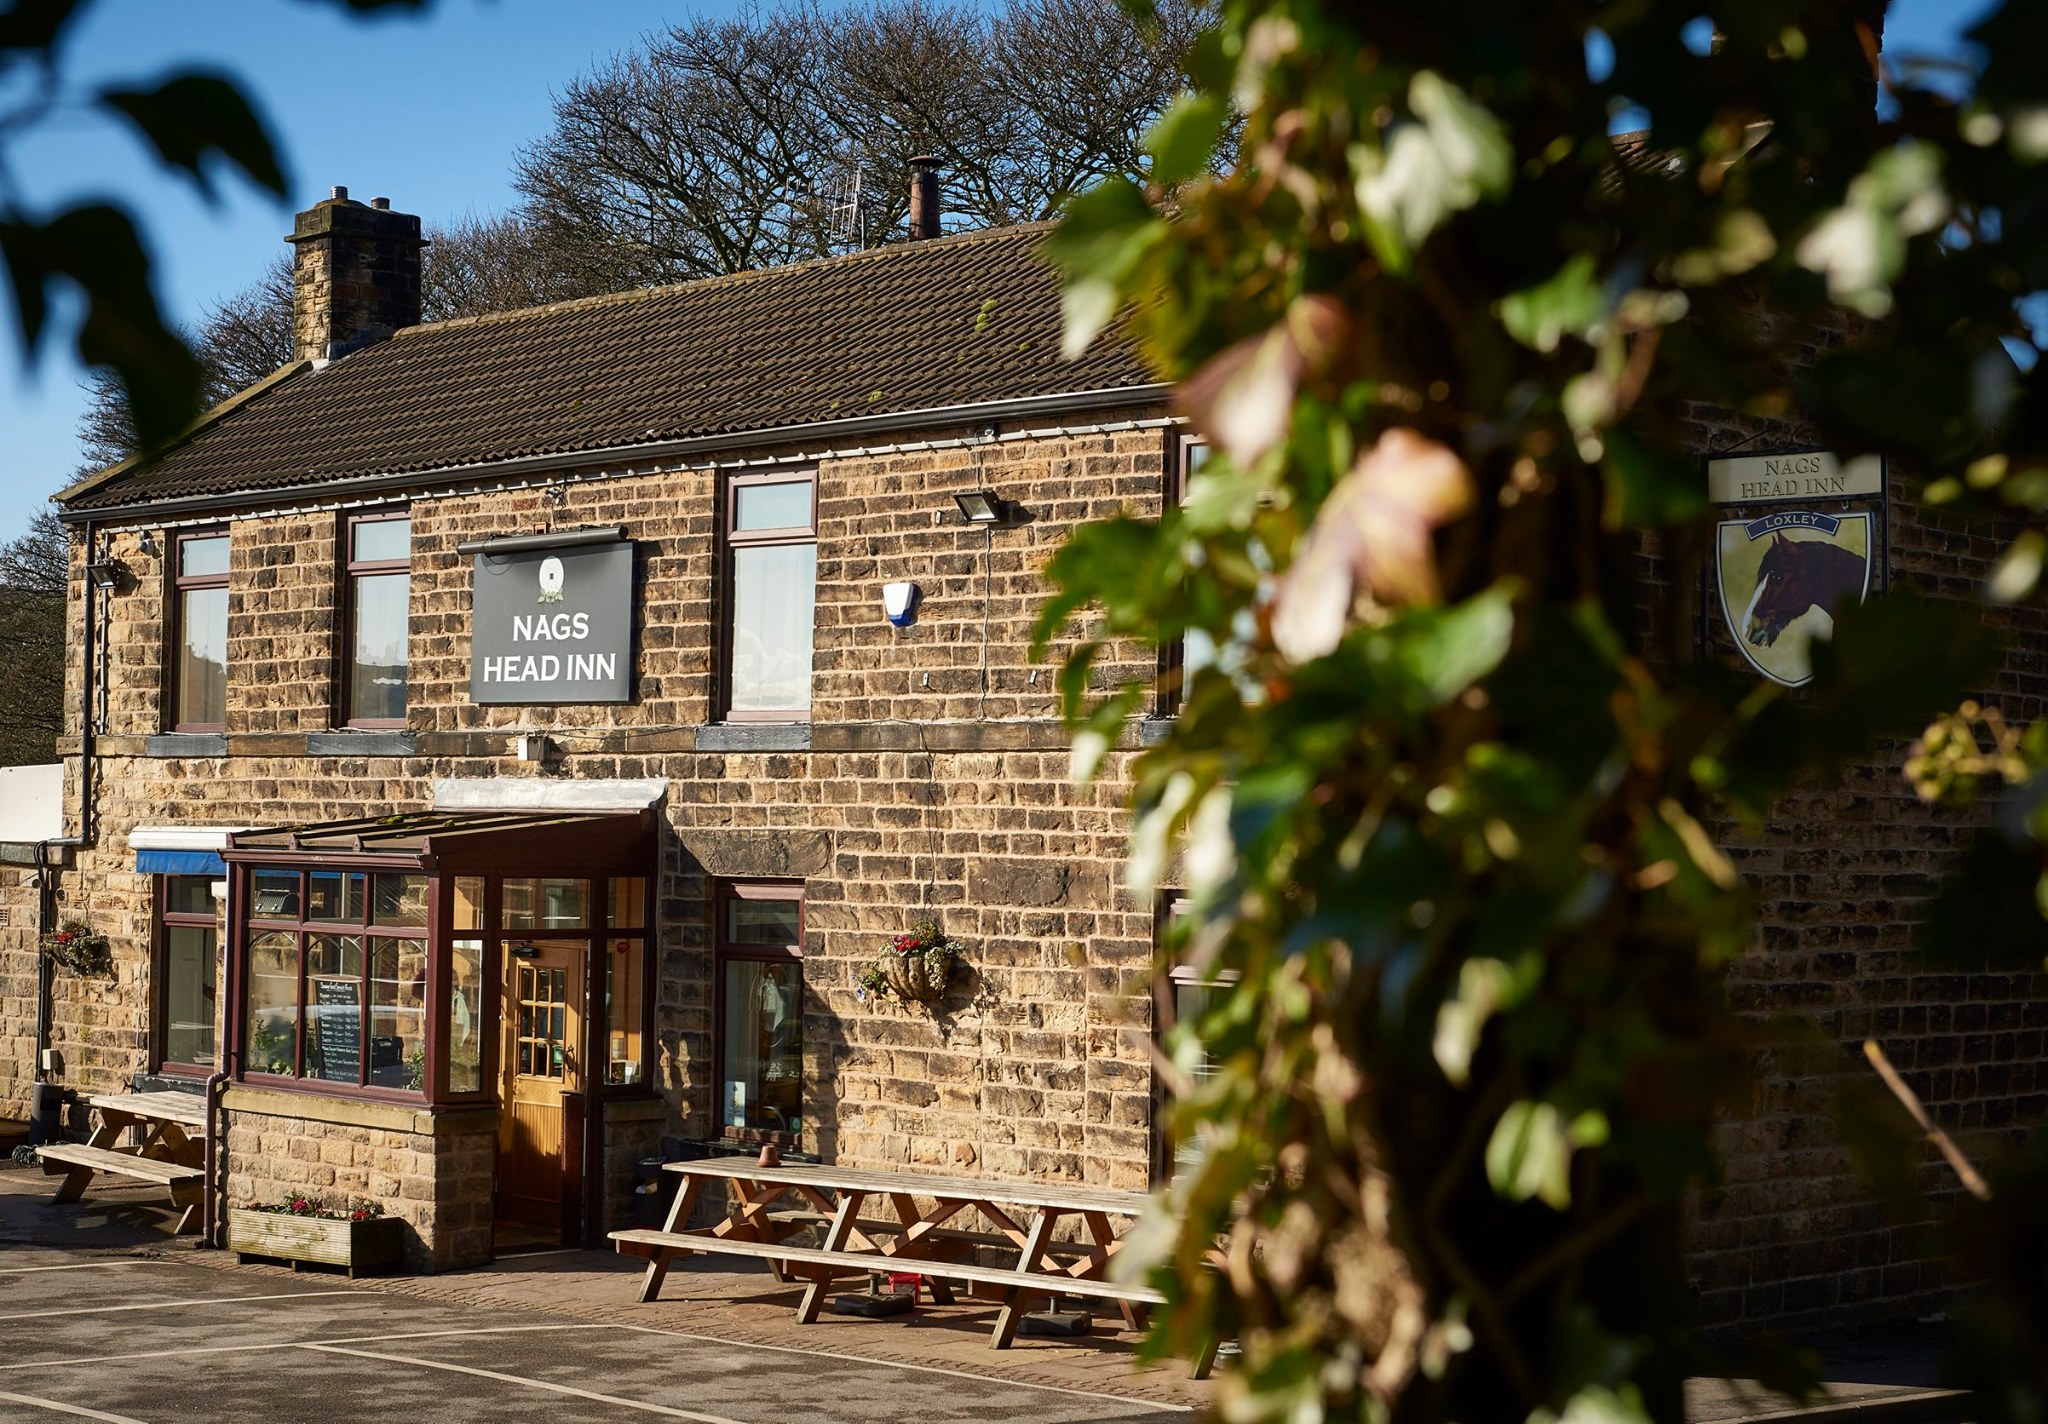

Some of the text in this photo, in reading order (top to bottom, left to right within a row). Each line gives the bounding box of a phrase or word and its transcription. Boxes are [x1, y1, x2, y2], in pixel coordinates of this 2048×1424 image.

[1765, 457, 1820, 476] NAGS
[1741, 476, 1847, 498] HEAD INN
[1765, 515, 1819, 528] LOXLEY
[512, 612, 590, 641] NAGS
[483, 653, 616, 682] HEAD INN
